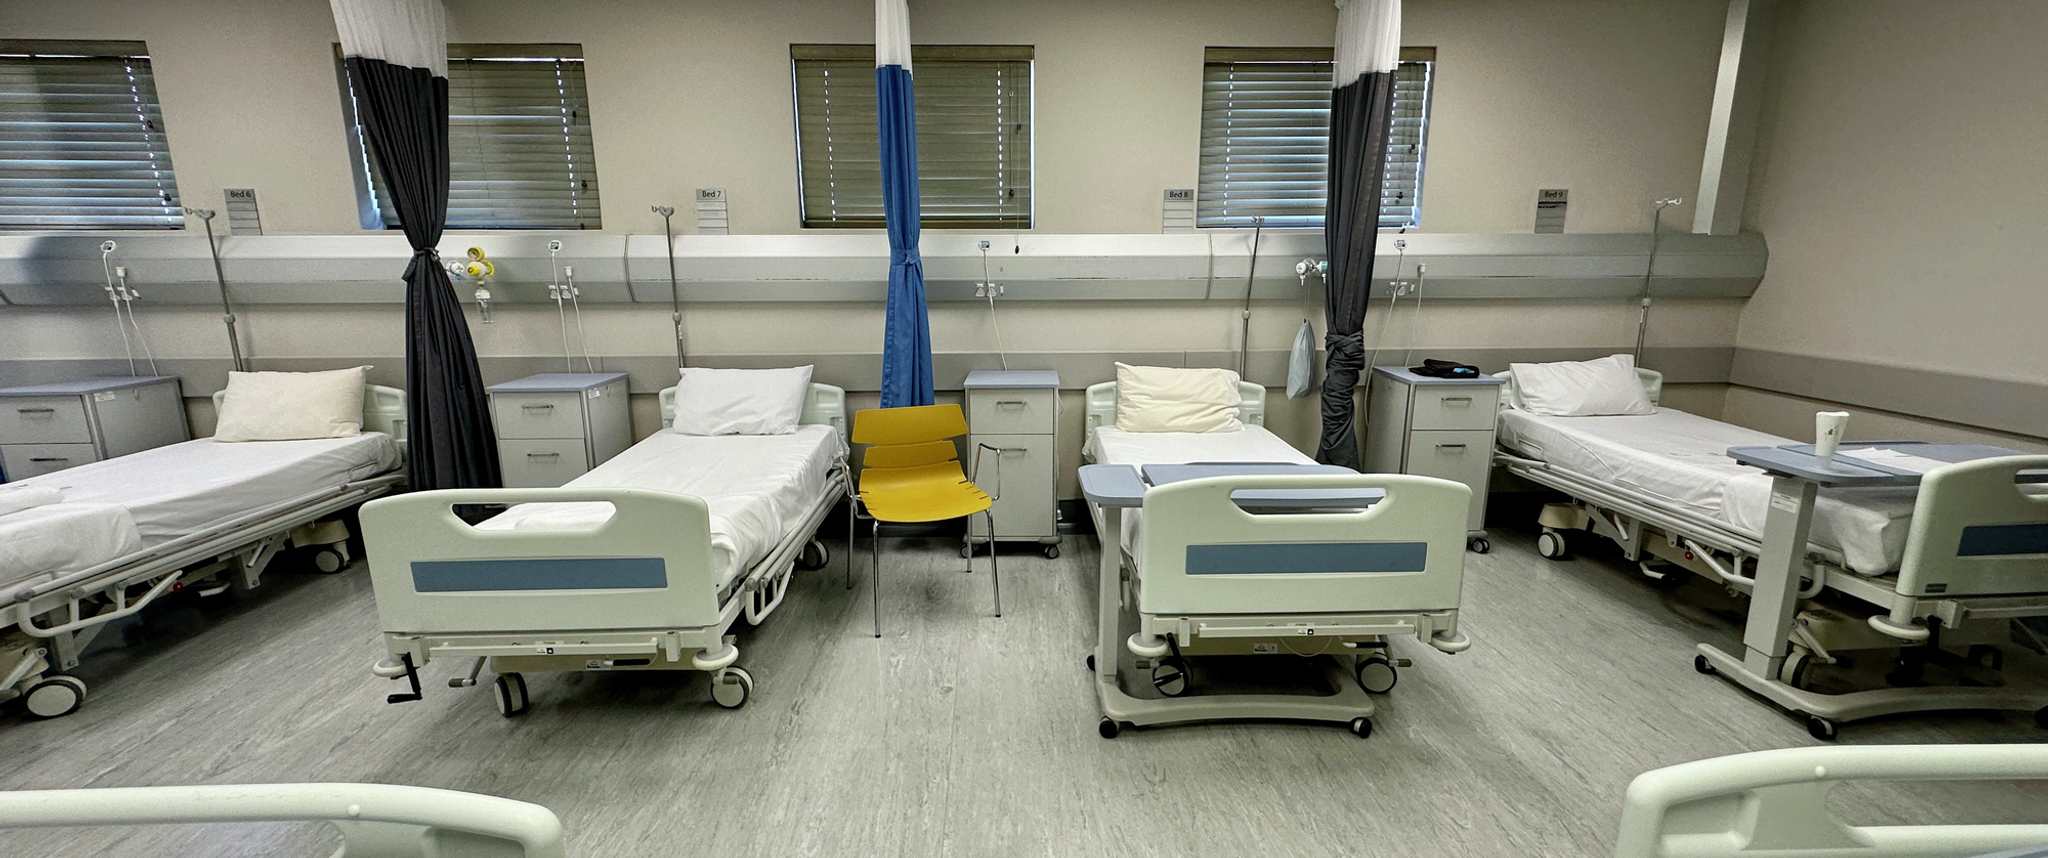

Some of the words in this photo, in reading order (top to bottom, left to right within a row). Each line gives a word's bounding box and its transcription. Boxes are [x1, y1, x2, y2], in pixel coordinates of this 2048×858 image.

[230, 190, 244, 198] Bed
[246, 190, 251, 198] 6
[702, 190, 715, 198] Bed
[717, 190, 721, 198] 7
[1169, 190, 1182, 198] Bed
[1184, 190, 1188, 198] 8
[1545, 190, 1557, 198] Bed
[1559, 190, 1563, 198] 9
